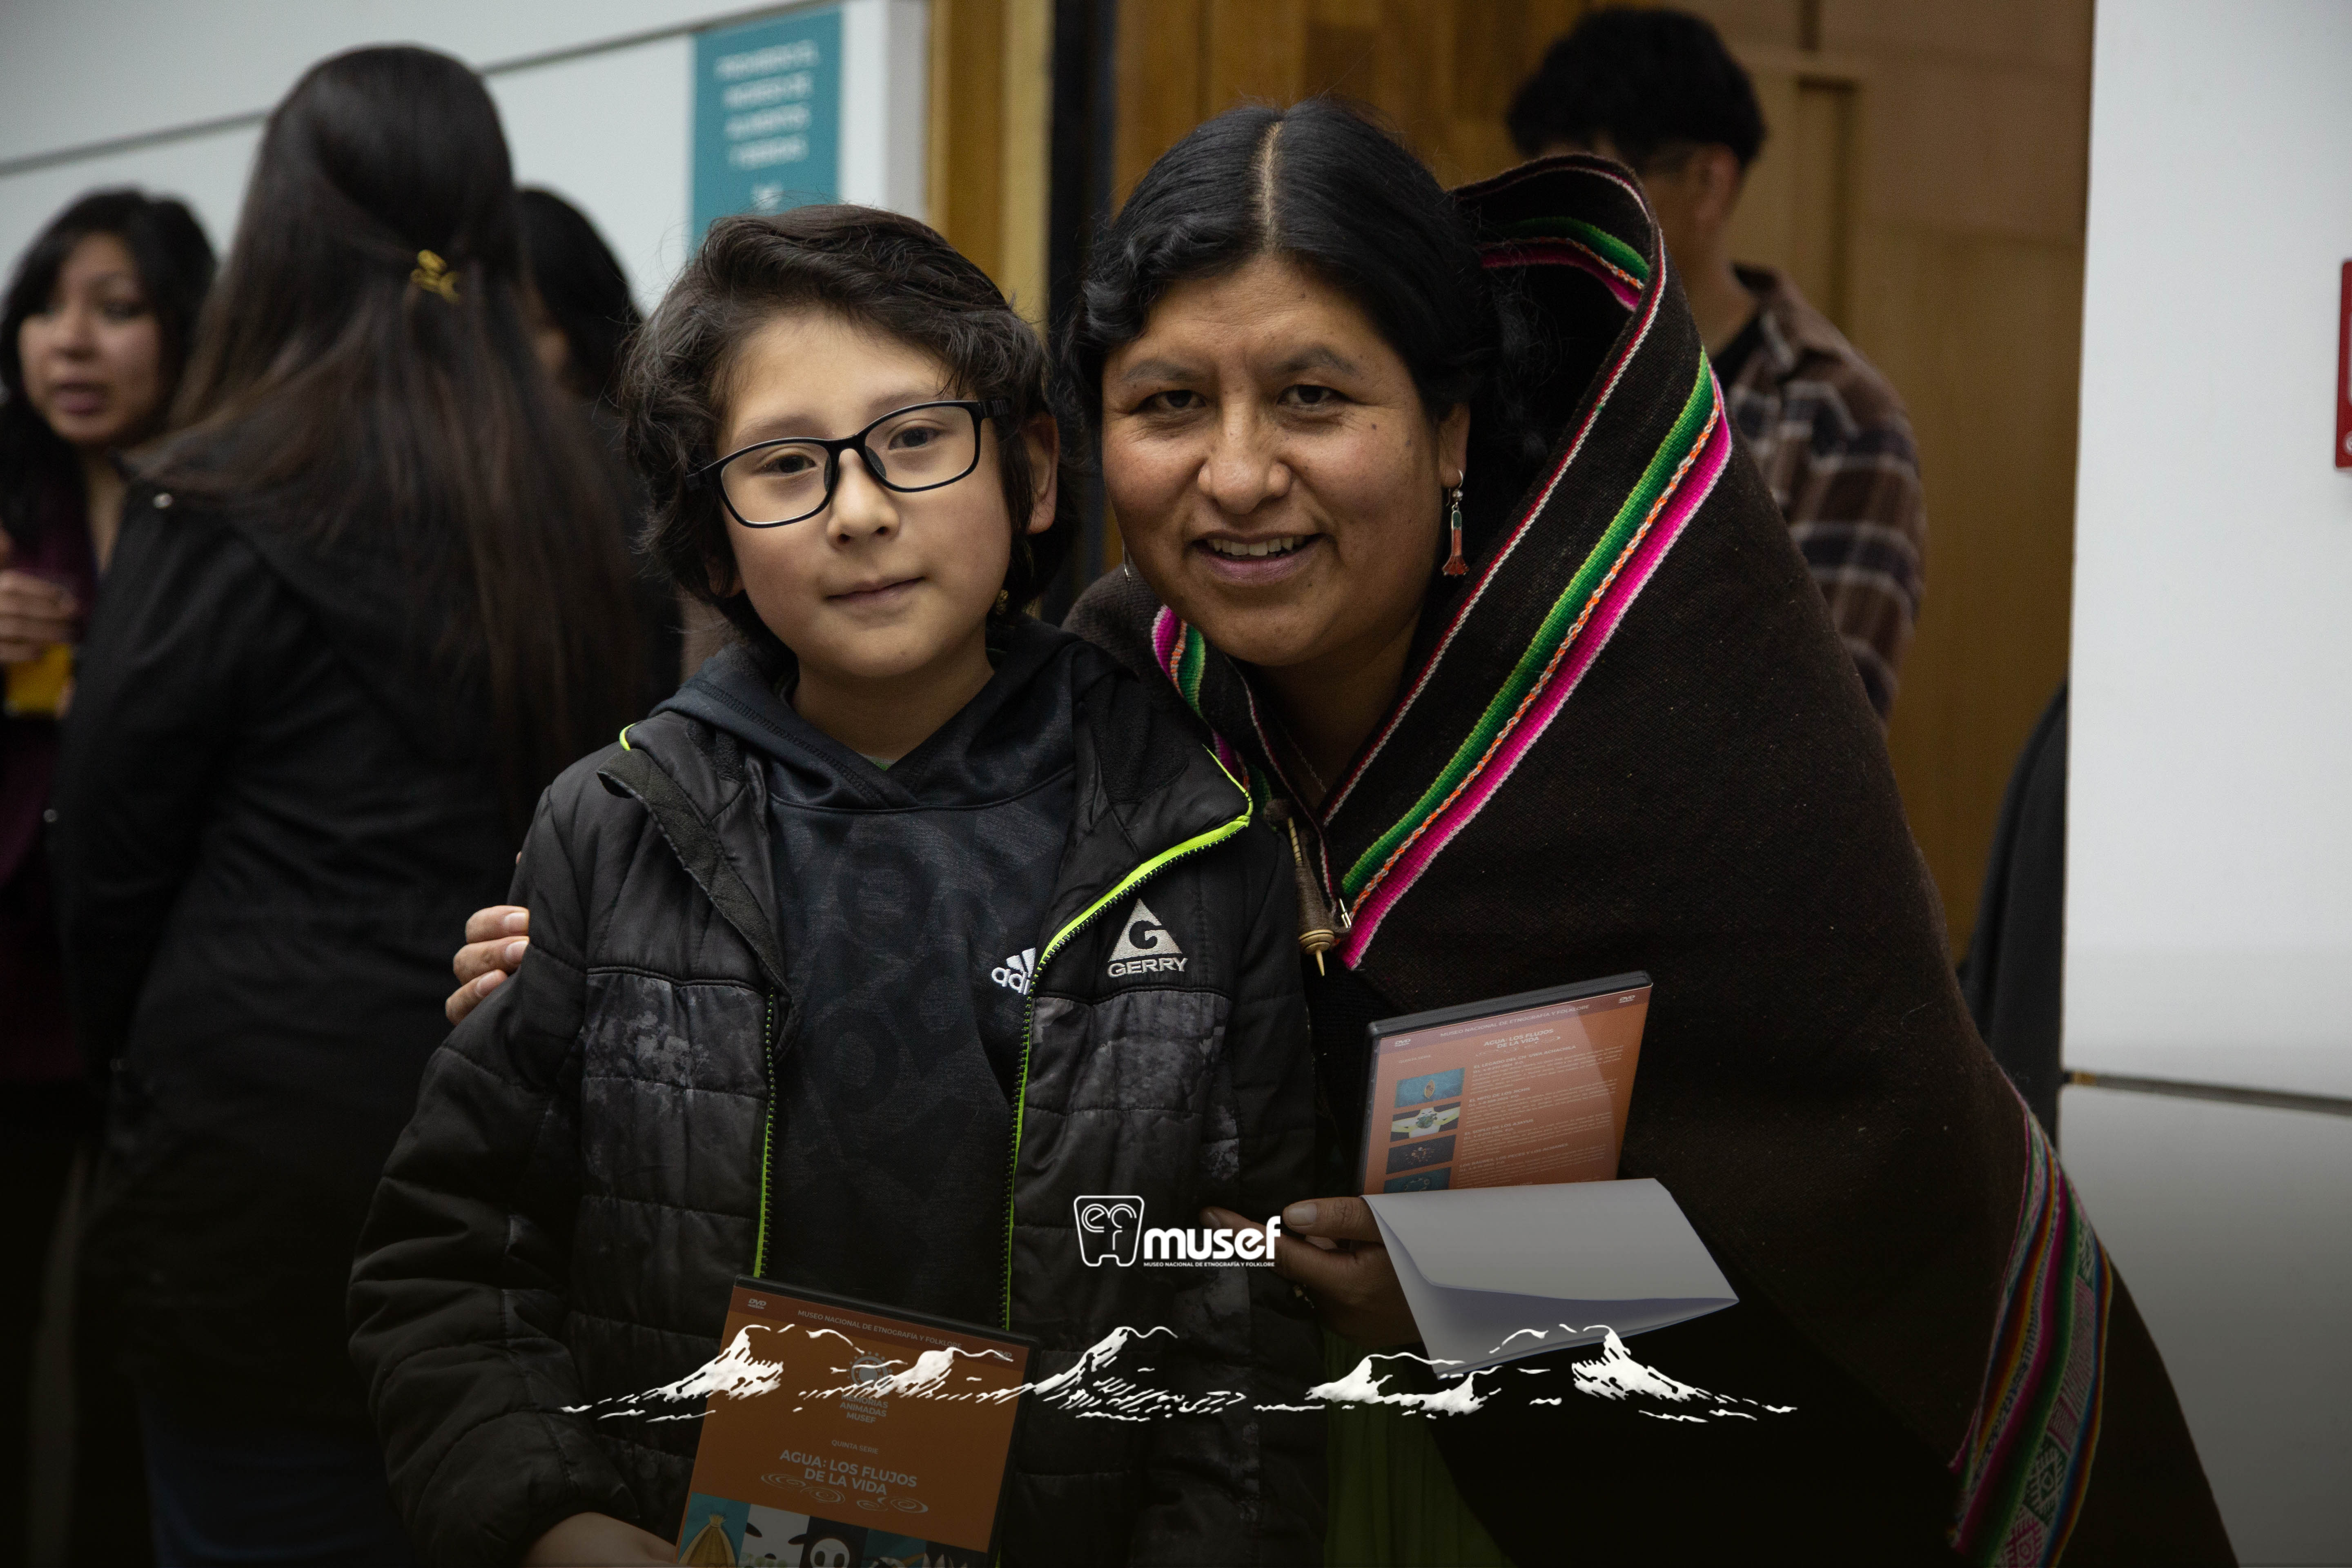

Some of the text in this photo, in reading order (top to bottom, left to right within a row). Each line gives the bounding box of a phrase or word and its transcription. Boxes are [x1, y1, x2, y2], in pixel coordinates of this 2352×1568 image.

[1107, 958, 1188, 978] GERRY
[991, 967, 1031, 995] adi
[1465, 1023, 1498, 1032] NACIONAL
[1557, 1004, 1590, 1015] FOLKLORE
[1525, 1028, 1554, 1038] FLUJOS
[748, 1298, 767, 1307] DVD
[798, 1310, 824, 1320] MUSEO
[824, 1315, 861, 1328] NACIONAL
[873, 1325, 918, 1340] ETNOGRAFÍA
[926, 1337, 962, 1349] FOLKLORE
[840, 1401, 887, 1417] ANIMADAS
[841, 1393, 889, 1409] MEMORIAS
[846, 1411, 876, 1423] MUSEF
[831, 1439, 879, 1454] QUINTA SERIE
[780, 1450, 917, 1488] AGUA: LOS FLUJOS
[804, 1468, 887, 1496] DE LA VIDA
